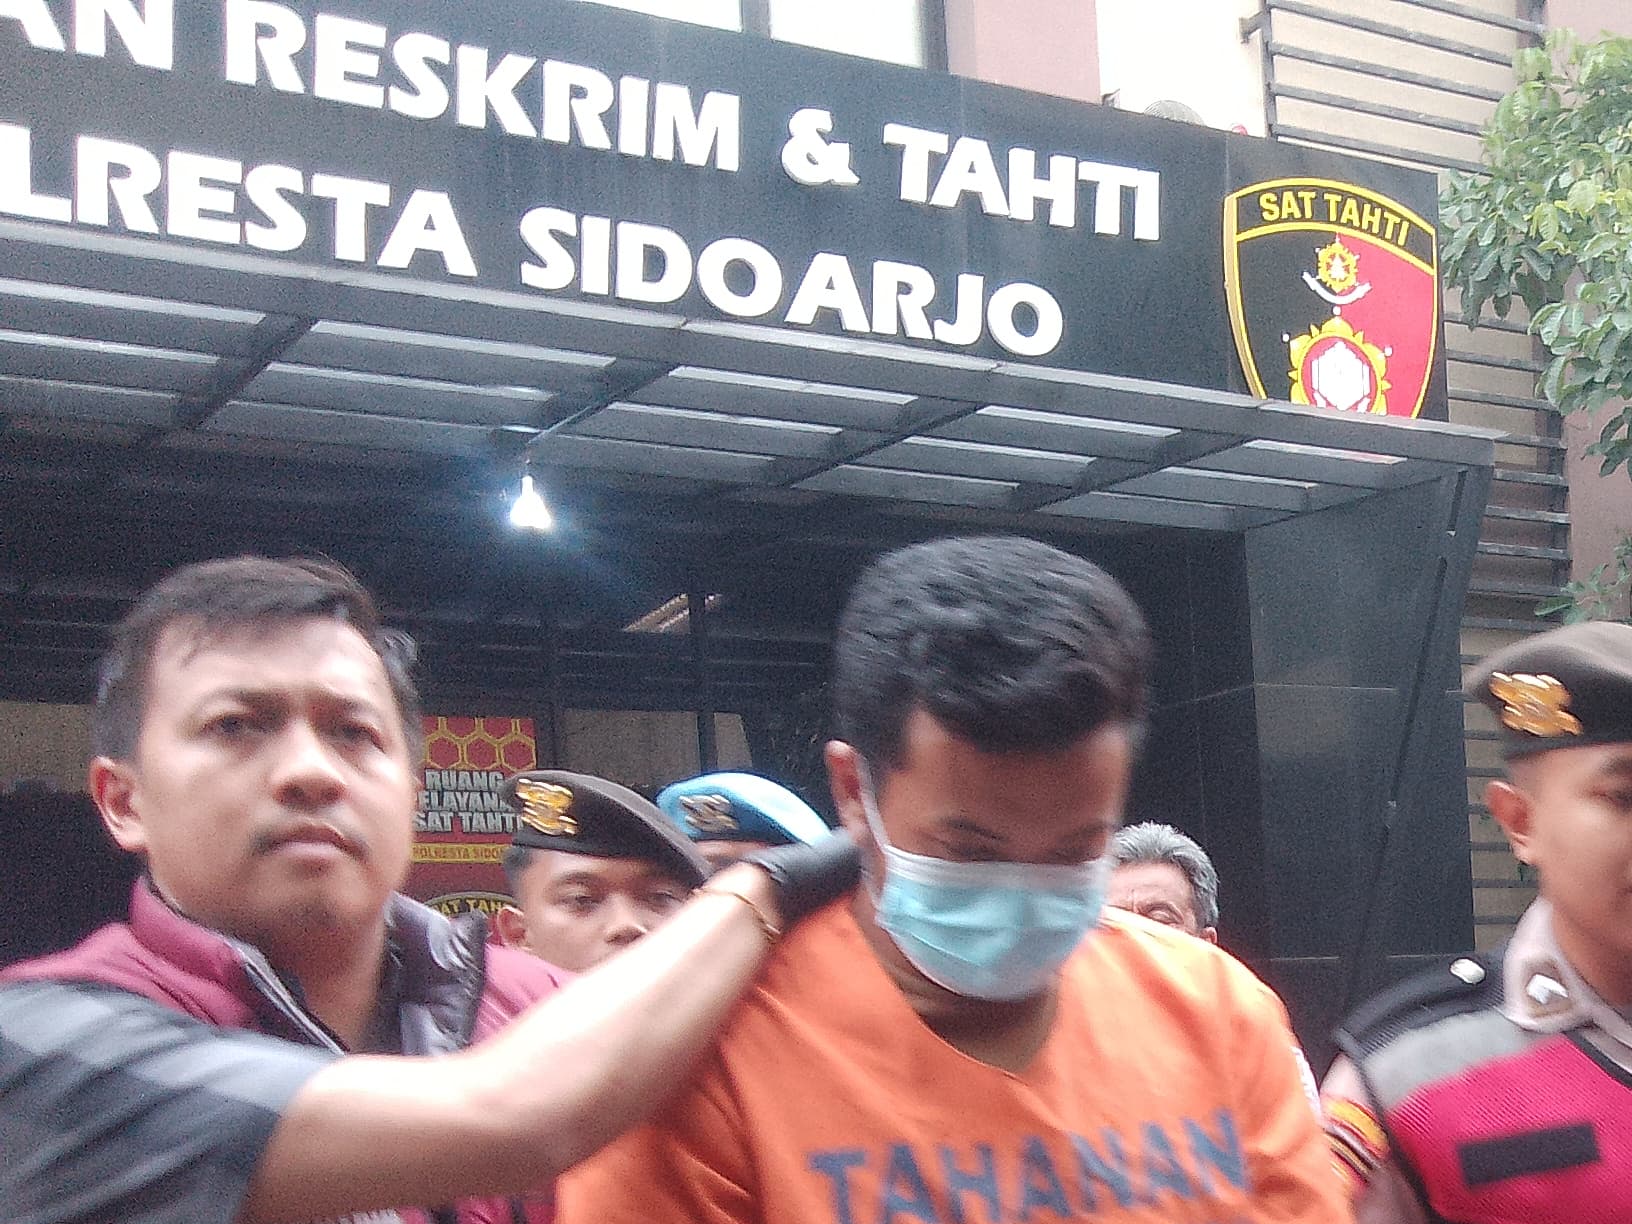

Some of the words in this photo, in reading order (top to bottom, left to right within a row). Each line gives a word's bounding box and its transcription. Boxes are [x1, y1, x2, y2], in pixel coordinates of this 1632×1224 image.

[224, 0, 740, 172] RESKRIM
[781, 107, 860, 186] &
[882, 122, 1161, 241] TAHTI
[519, 206, 1063, 357] SIDOARJO
[1259, 191, 1316, 222] SAT
[1323, 193, 1410, 246] TAHTI
